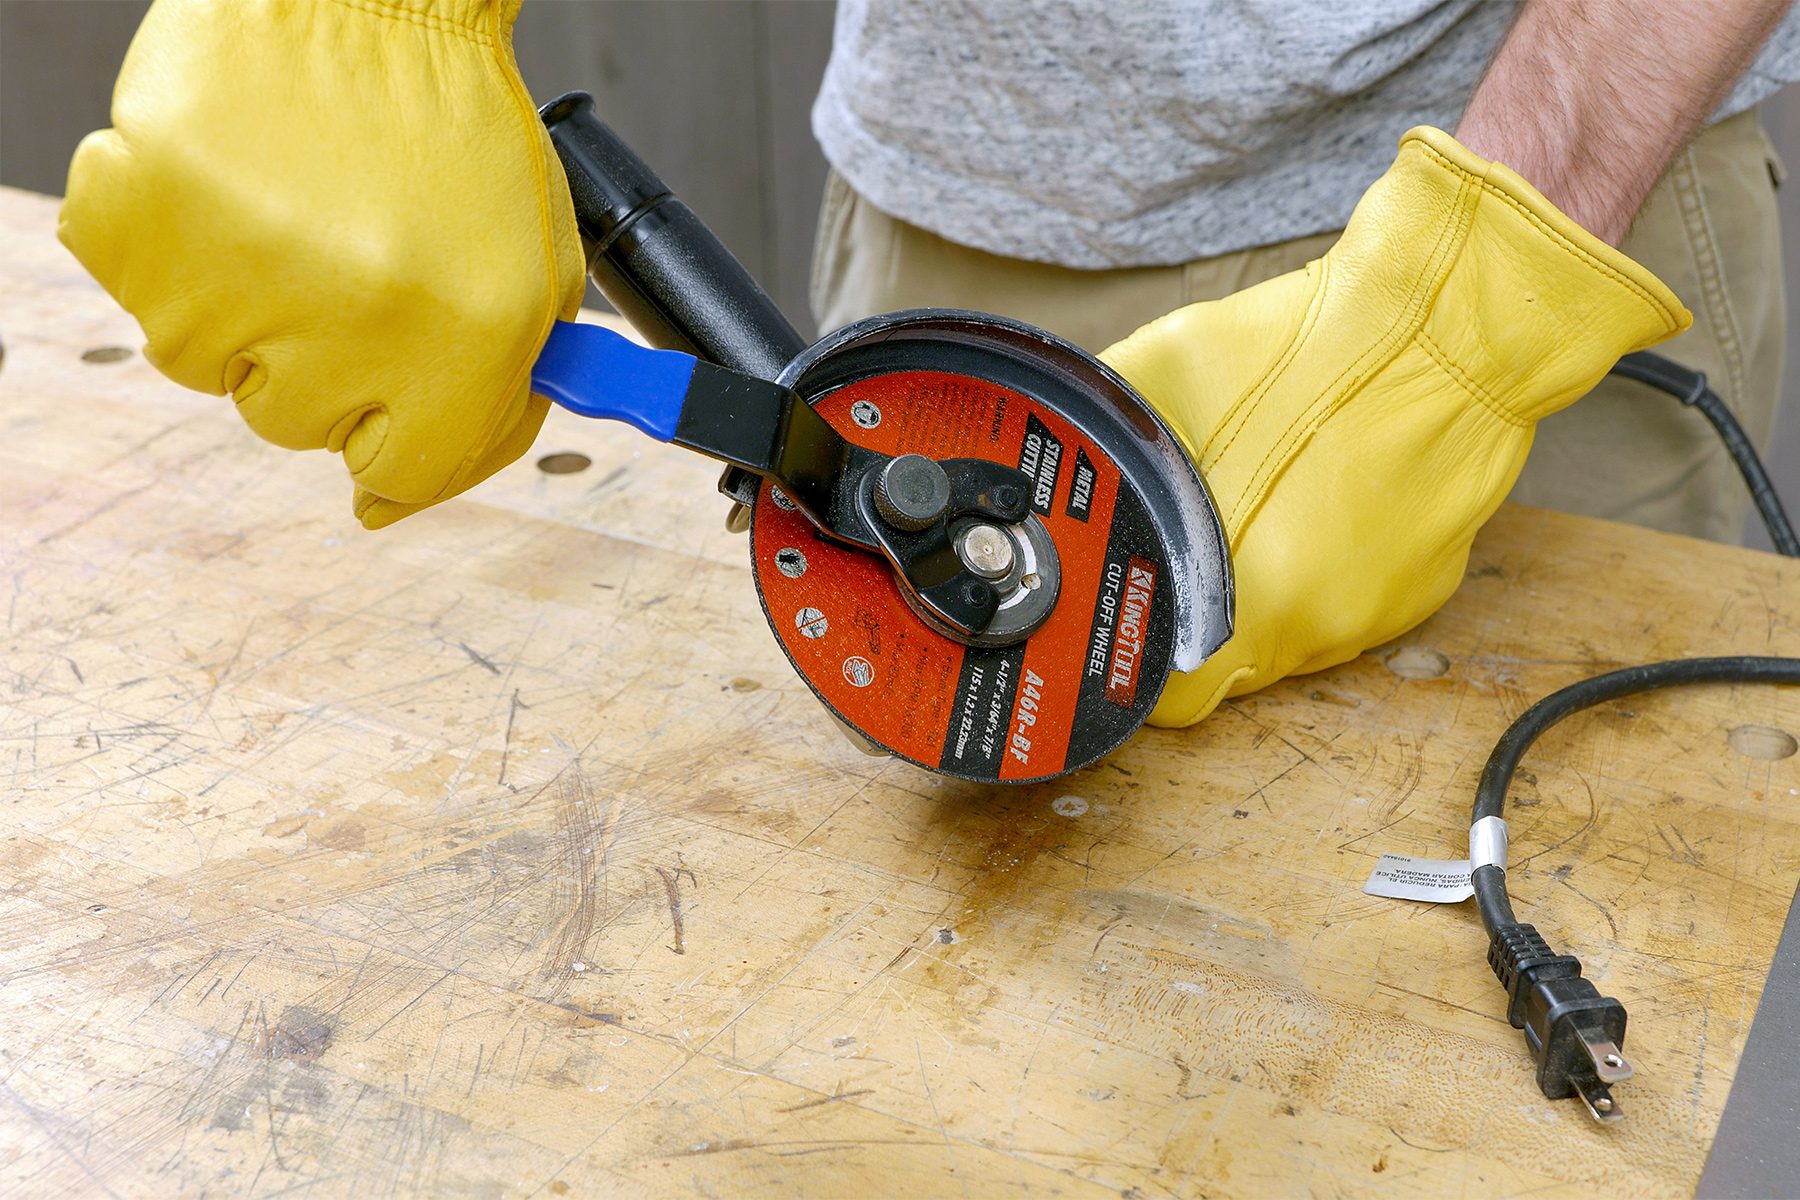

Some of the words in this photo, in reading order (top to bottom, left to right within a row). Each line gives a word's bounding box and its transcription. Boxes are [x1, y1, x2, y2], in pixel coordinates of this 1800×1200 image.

[1021, 433, 1042, 478] CUTTI
[1034, 439, 1060, 509] STAINLESS
[1072, 466, 1093, 511] METAL
[1100, 563, 1122, 626] CUT-OFF
[1088, 626, 1111, 677] WHEEL
[971, 666, 984, 686] 115
[996, 659, 1010, 693] 4-1/2"
[965, 693, 978, 709] 1.2
[1010, 668, 1044, 765] A46R-BF
[955, 716, 973, 759] 22.23mm
[982, 735, 994, 759] 7/8"
[1376, 870, 1406, 879] UTILICE
[1400, 880, 1436, 888] REDUCIR
